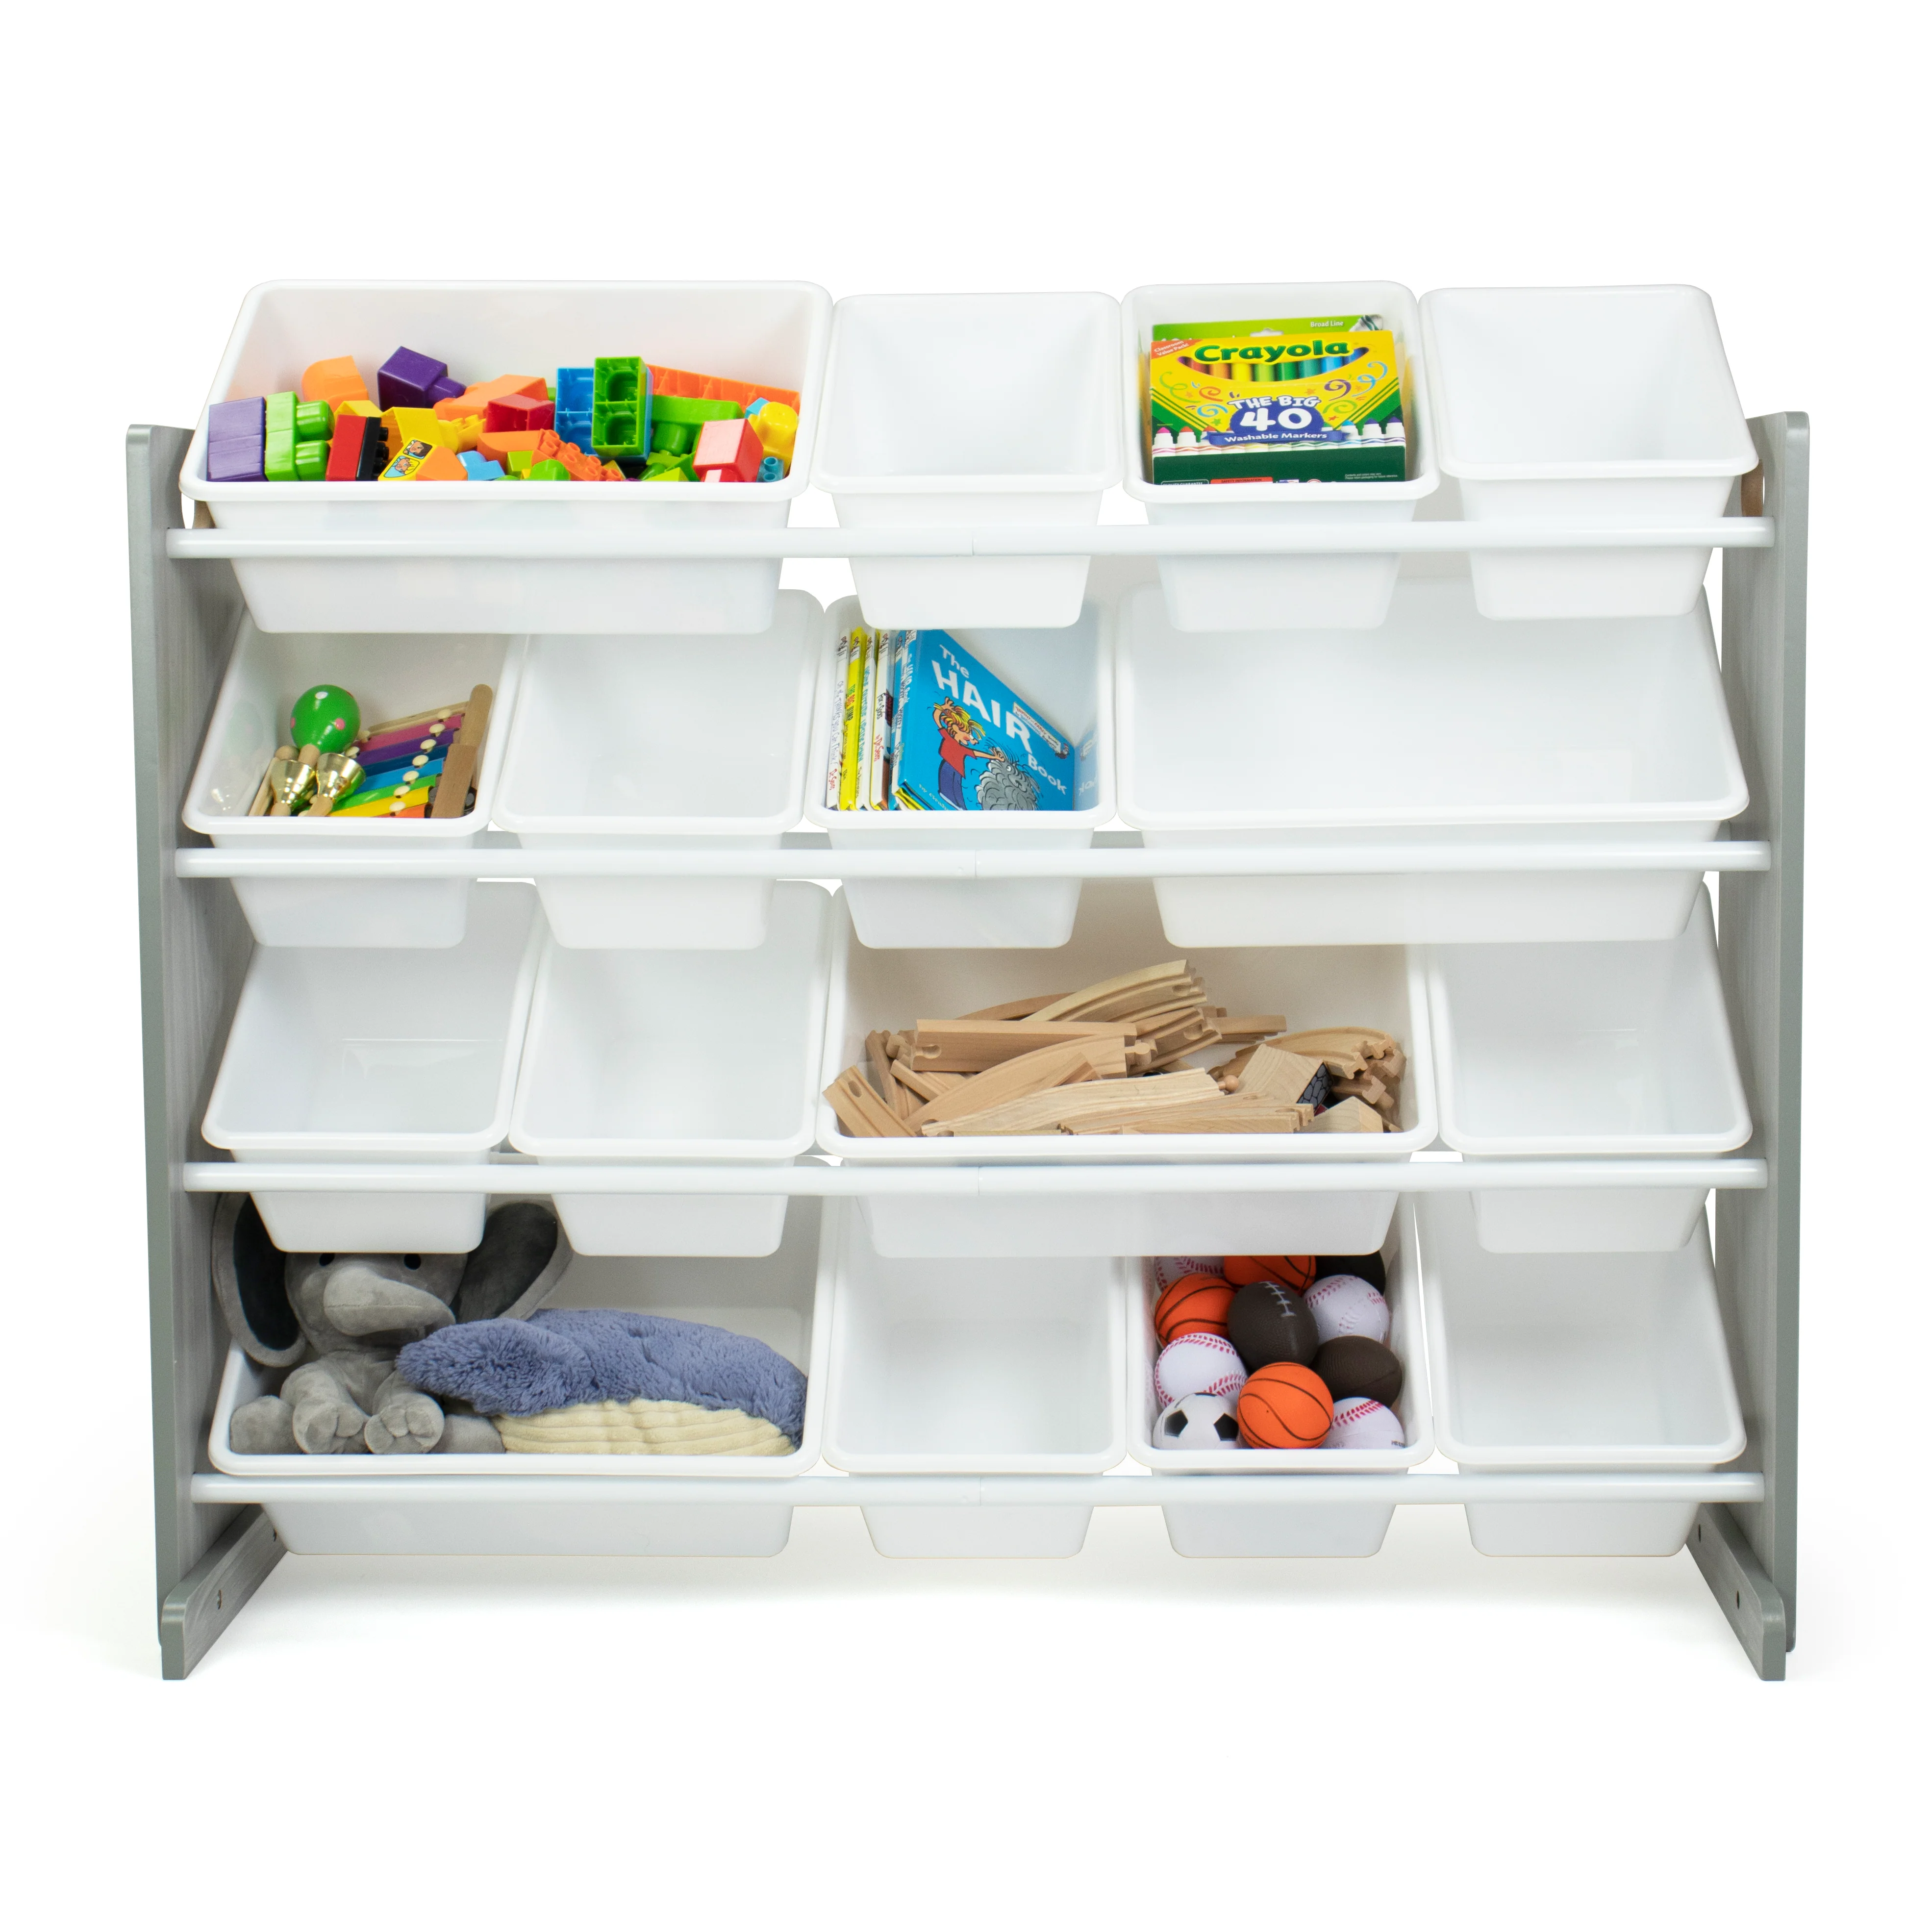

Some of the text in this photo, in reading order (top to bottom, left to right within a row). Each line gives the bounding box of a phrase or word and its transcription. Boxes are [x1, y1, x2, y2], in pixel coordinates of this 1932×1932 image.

[1154, 341, 1184, 352] Classroom
[1195, 340, 1350, 363] Crayola
[1227, 396, 1322, 409] THE BIG
[1240, 407, 1312, 431] 40
[1224, 433, 1279, 442] Washable
[939, 644, 970, 678] The
[932, 660, 1032, 754] HAIR
[874, 745, 884, 762] Seuss
[1028, 753, 1067, 795] Book
